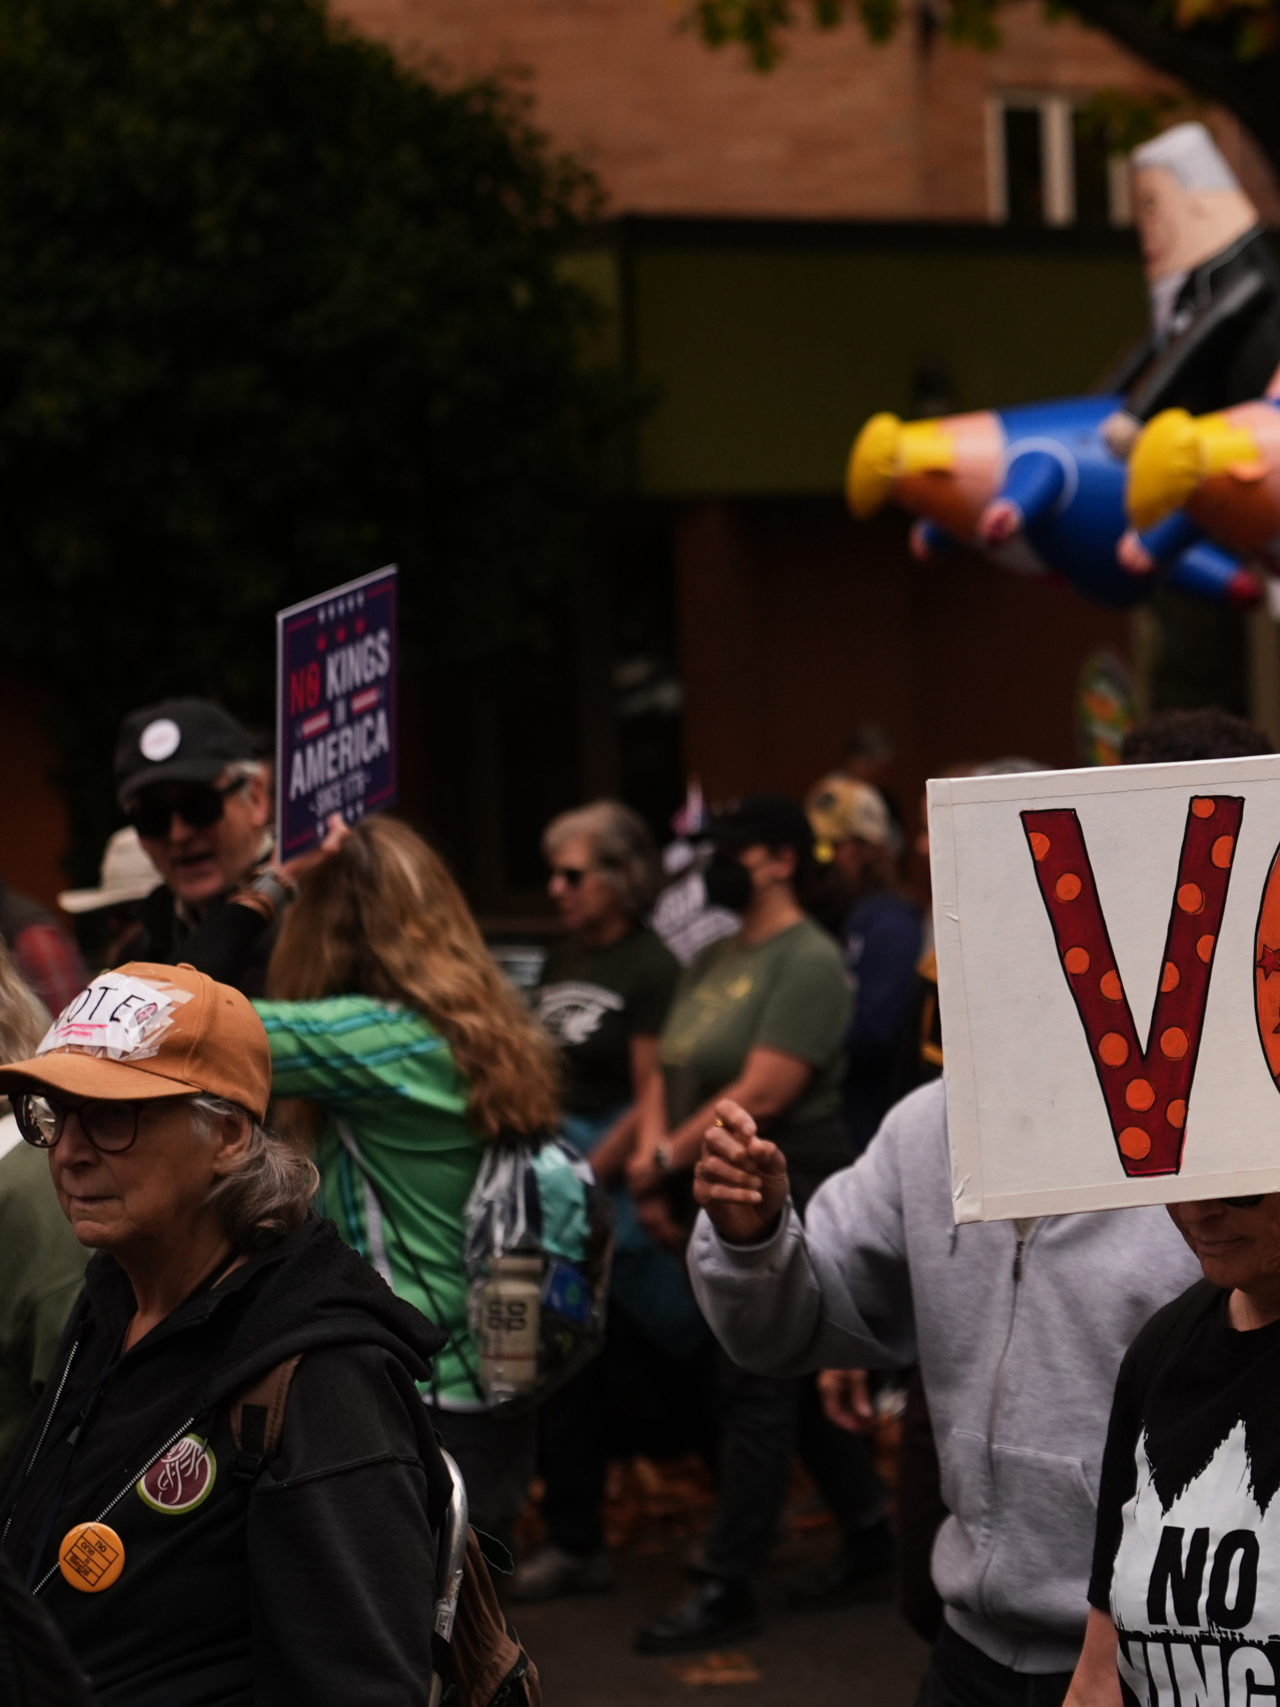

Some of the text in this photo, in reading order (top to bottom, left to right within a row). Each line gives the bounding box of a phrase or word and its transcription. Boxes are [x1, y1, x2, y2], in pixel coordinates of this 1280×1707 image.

[289, 628, 390, 717] NO KINGS
[289, 708, 390, 800] AMERICA
[81, 1542, 95, 1556] one
[95, 1540, 107, 1553] no
[1147, 1525, 1260, 1630] NO
